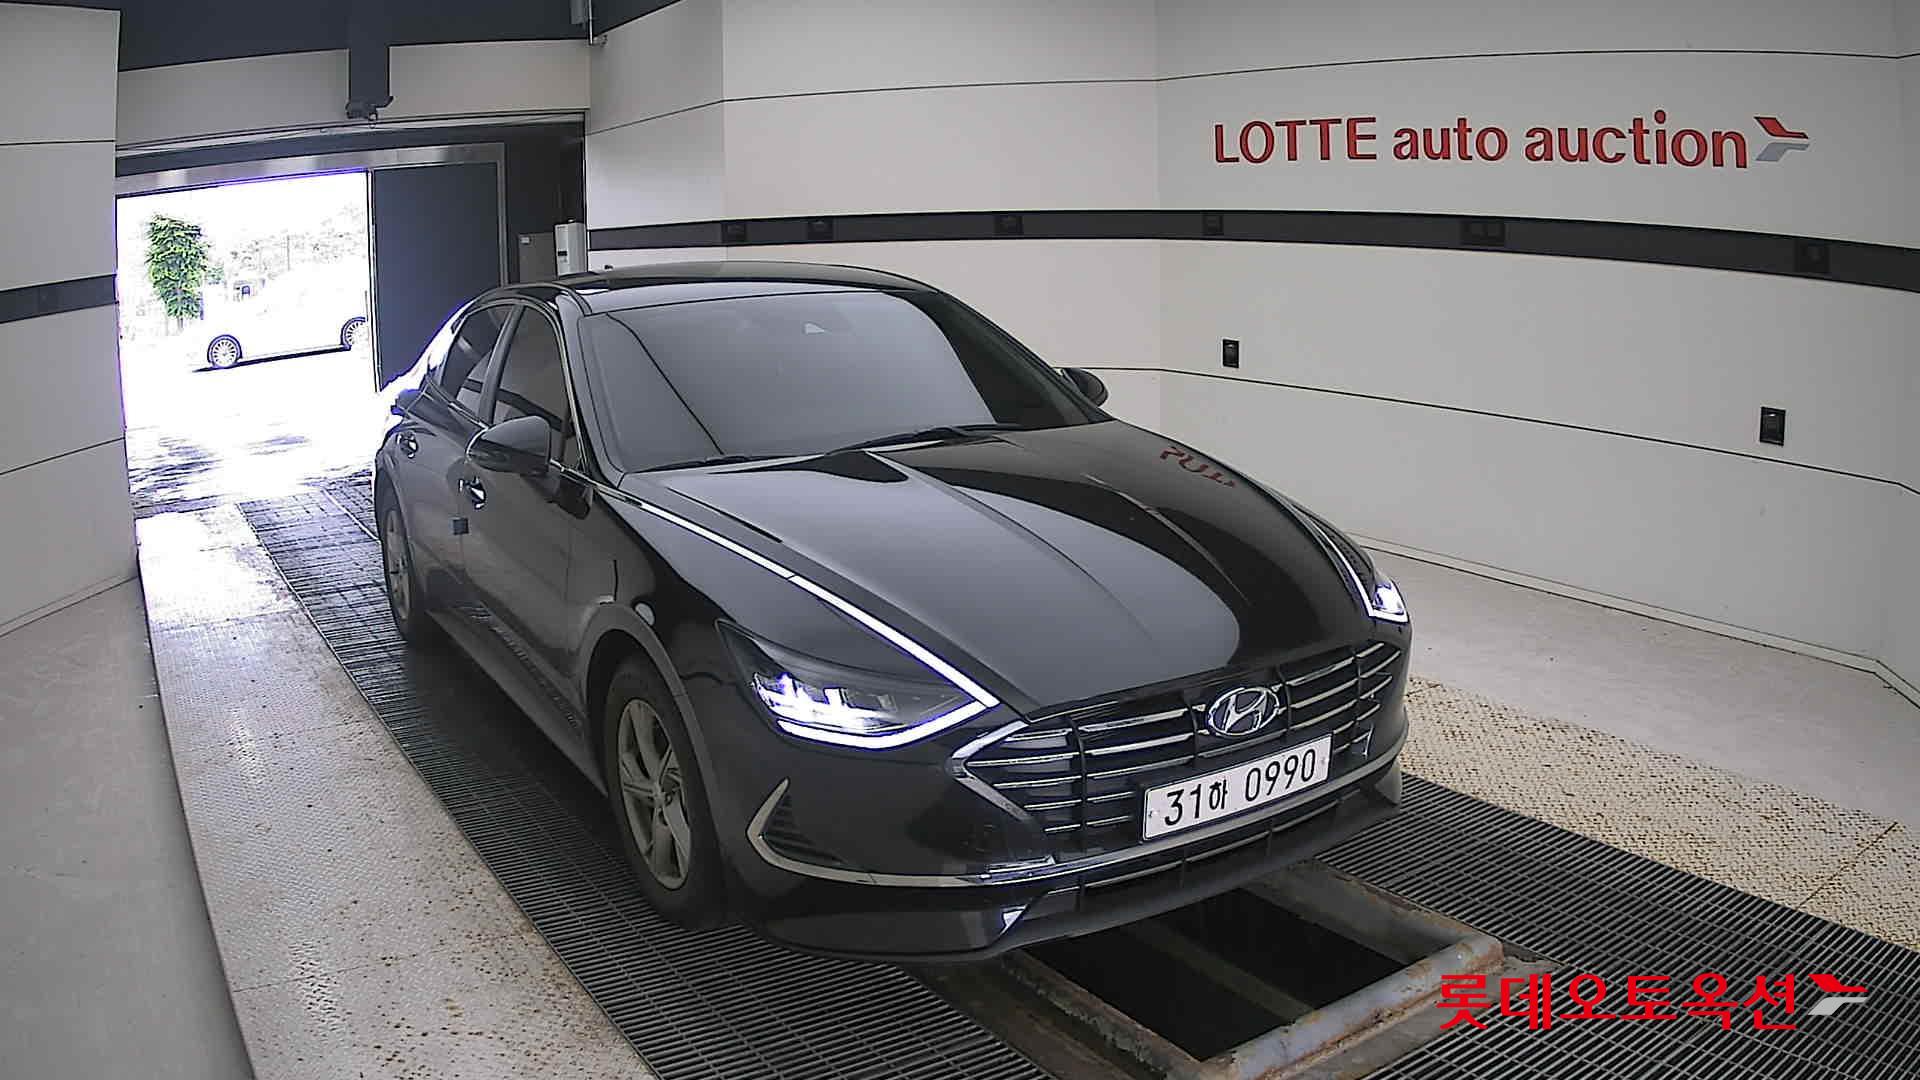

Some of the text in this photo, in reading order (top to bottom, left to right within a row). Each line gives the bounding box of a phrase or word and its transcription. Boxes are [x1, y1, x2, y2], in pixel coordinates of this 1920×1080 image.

[1214, 110, 1748, 169] LOTTE auto auction
[1163, 749, 1317, 827] 31하 0990
